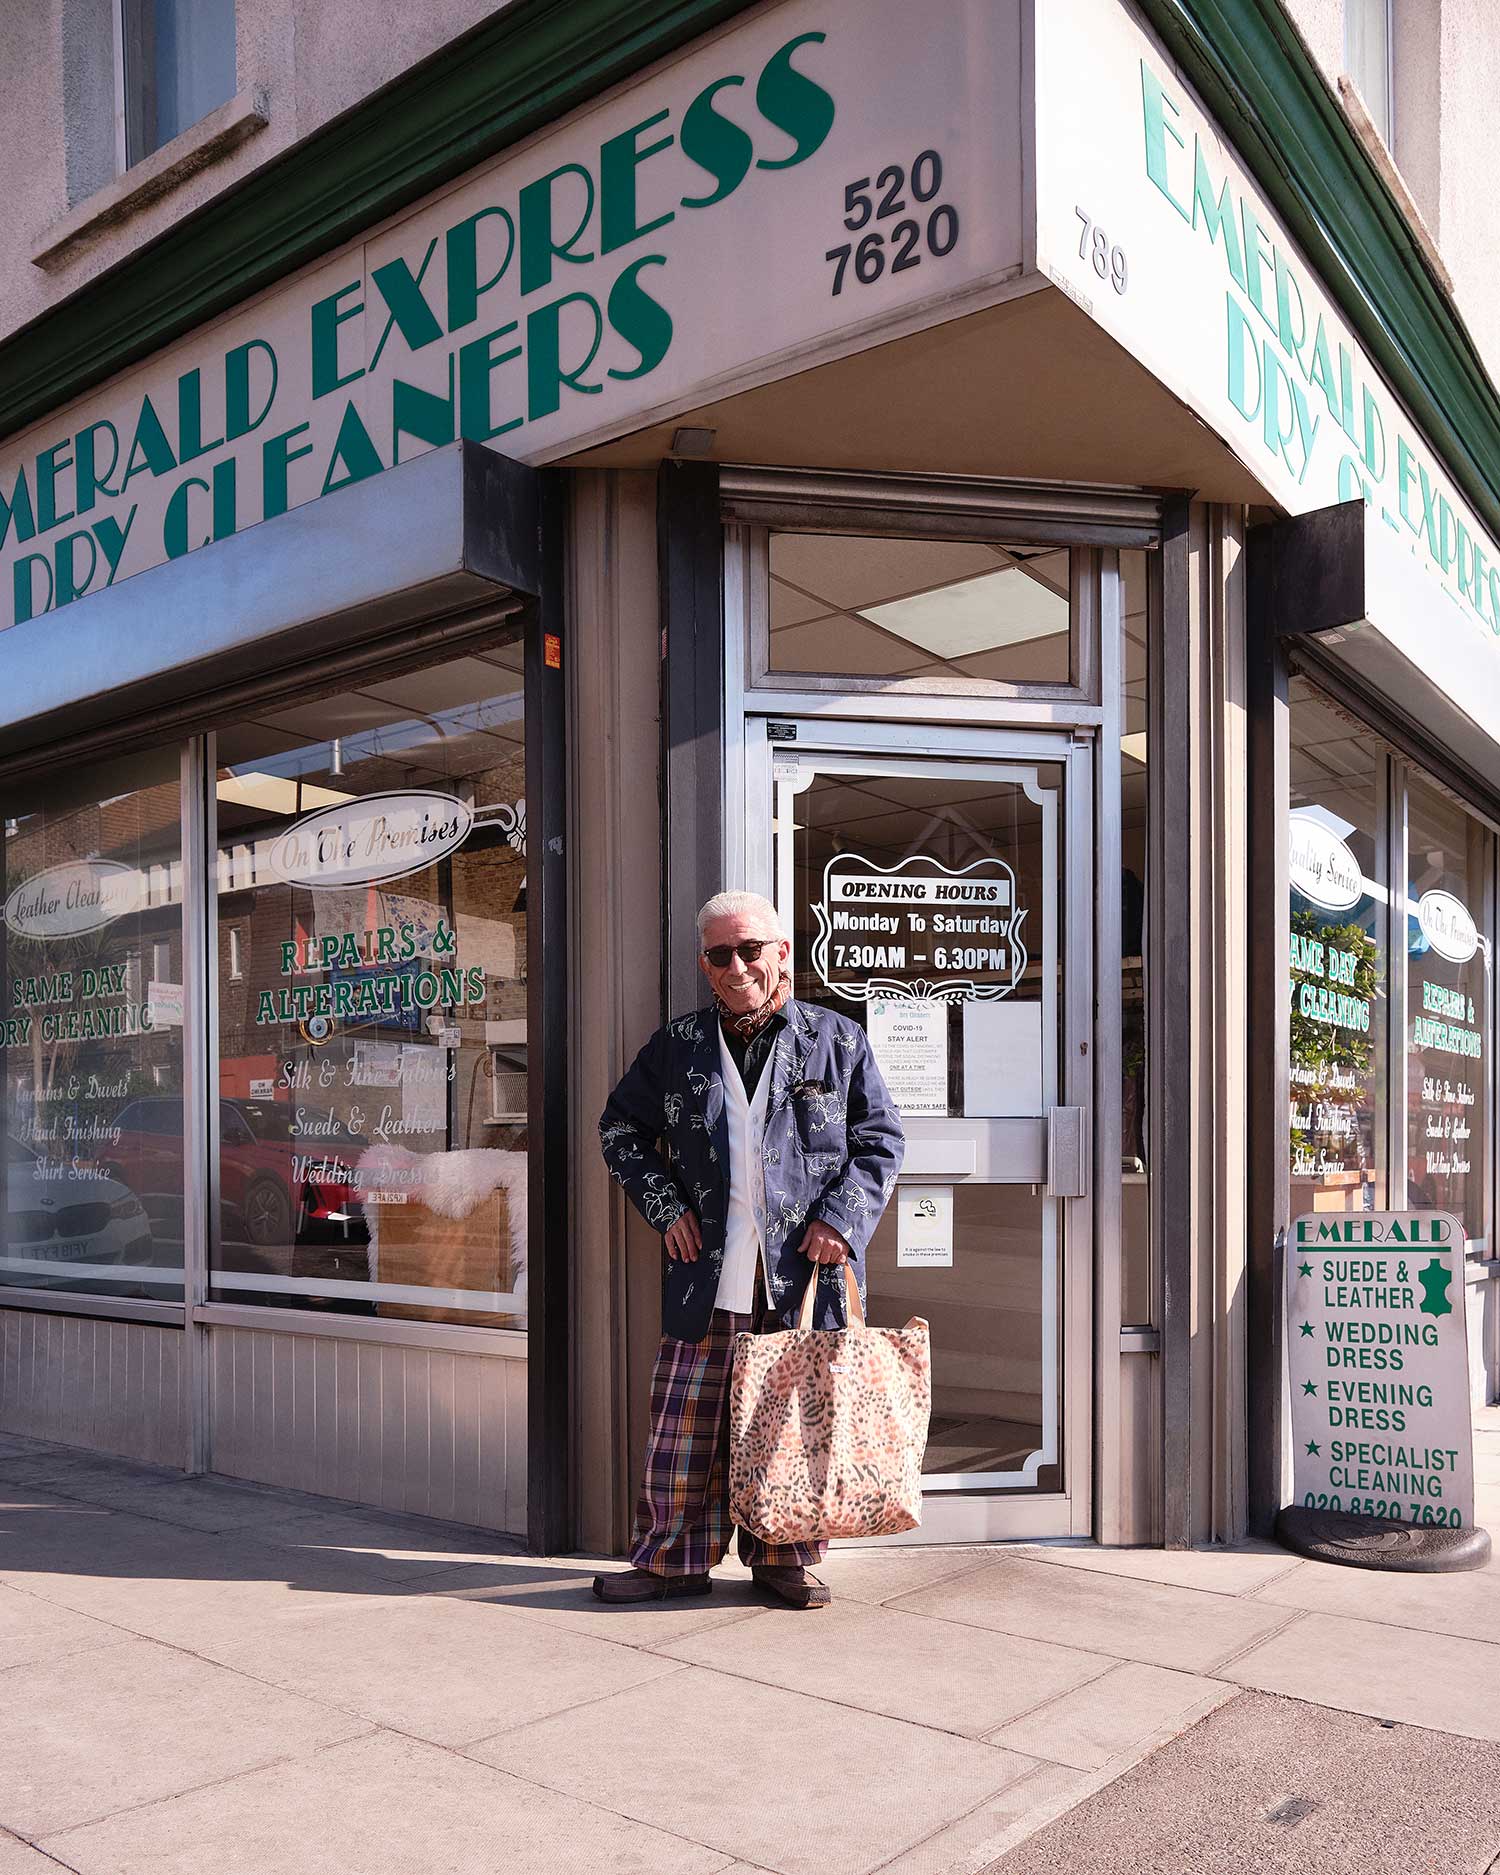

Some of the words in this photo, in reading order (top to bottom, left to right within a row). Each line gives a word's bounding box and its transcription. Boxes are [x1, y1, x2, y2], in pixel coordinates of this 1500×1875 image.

[843, 149, 943, 231] 520
[824, 203, 961, 296] 7620
[1074, 205, 1130, 296] 789
[1140, 58, 1387, 484] EMERALD
[0, 338, 279, 552] MERALD
[310, 32, 836, 400] EXPRESS
[1226, 290, 1321, 486] DRY
[12, 502, 139, 625] DRY
[162, 253, 675, 562] CLEANERS
[317, 825, 357, 863] The
[364, 813, 460, 857] Premises
[841, 882, 927, 898] OPENING
[935, 886, 998, 901] HOURS
[1327, 852, 1358, 894] Service
[11, 887, 61, 927] Leather
[832, 911, 900, 935] Monday
[907, 913, 926, 932] To
[932, 914, 1009, 937] Saturday
[280, 923, 417, 976] REPAIRS
[431, 918, 456, 957] &
[834, 945, 906, 969] 7.30AM
[934, 947, 1006, 970] 6.30PM
[1289, 932, 1325, 978] AME
[1328, 946, 1358, 987] DAY
[13, 972, 73, 1009] SAME
[82, 964, 129, 999] DAY
[256, 966, 486, 1026] ALTERATIONS
[1423, 980, 1466, 1021] REPAIRS
[0, 1017, 33, 1049] DRY
[41, 1002, 155, 1044] CLEANING
[1300, 982, 1370, 1033] CLEANING
[1413, 1015, 1482, 1059] ALTERATIONS
[67, 1075, 81, 1100] &
[85, 1074, 128, 1099] Duvets
[278, 1060, 313, 1090] Silk
[319, 1058, 337, 1087] &
[62, 1114, 122, 1146] Finishing
[290, 1107, 341, 1136] Suede
[347, 1105, 366, 1135] &
[32, 1156, 64, 1180] Shirt
[68, 1156, 111, 1181] Service
[292, 1155, 365, 1192] Wedding
[1292, 1148, 1316, 1176] Shirt
[1318, 1148, 1344, 1176] Service
[1296, 1219, 1452, 1243] EMERALD
[1322, 1260, 1388, 1283] SUEDE
[1396, 1260, 1409, 1283] &
[1324, 1286, 1415, 1309] LEATHER
[1324, 1321, 1439, 1346] WEDDING
[1326, 1346, 1404, 1371] DRESS
[1327, 1380, 1433, 1407] EVENING
[1329, 1406, 1406, 1432] DRESS
[1331, 1441, 1458, 1472] SPECIALIST
[1329, 1466, 1443, 1498] CLEANING
[1304, 1492, 1342, 1512] 020
[1350, 1497, 1400, 1520] 8520
[1410, 1503, 1462, 1529] 7620
